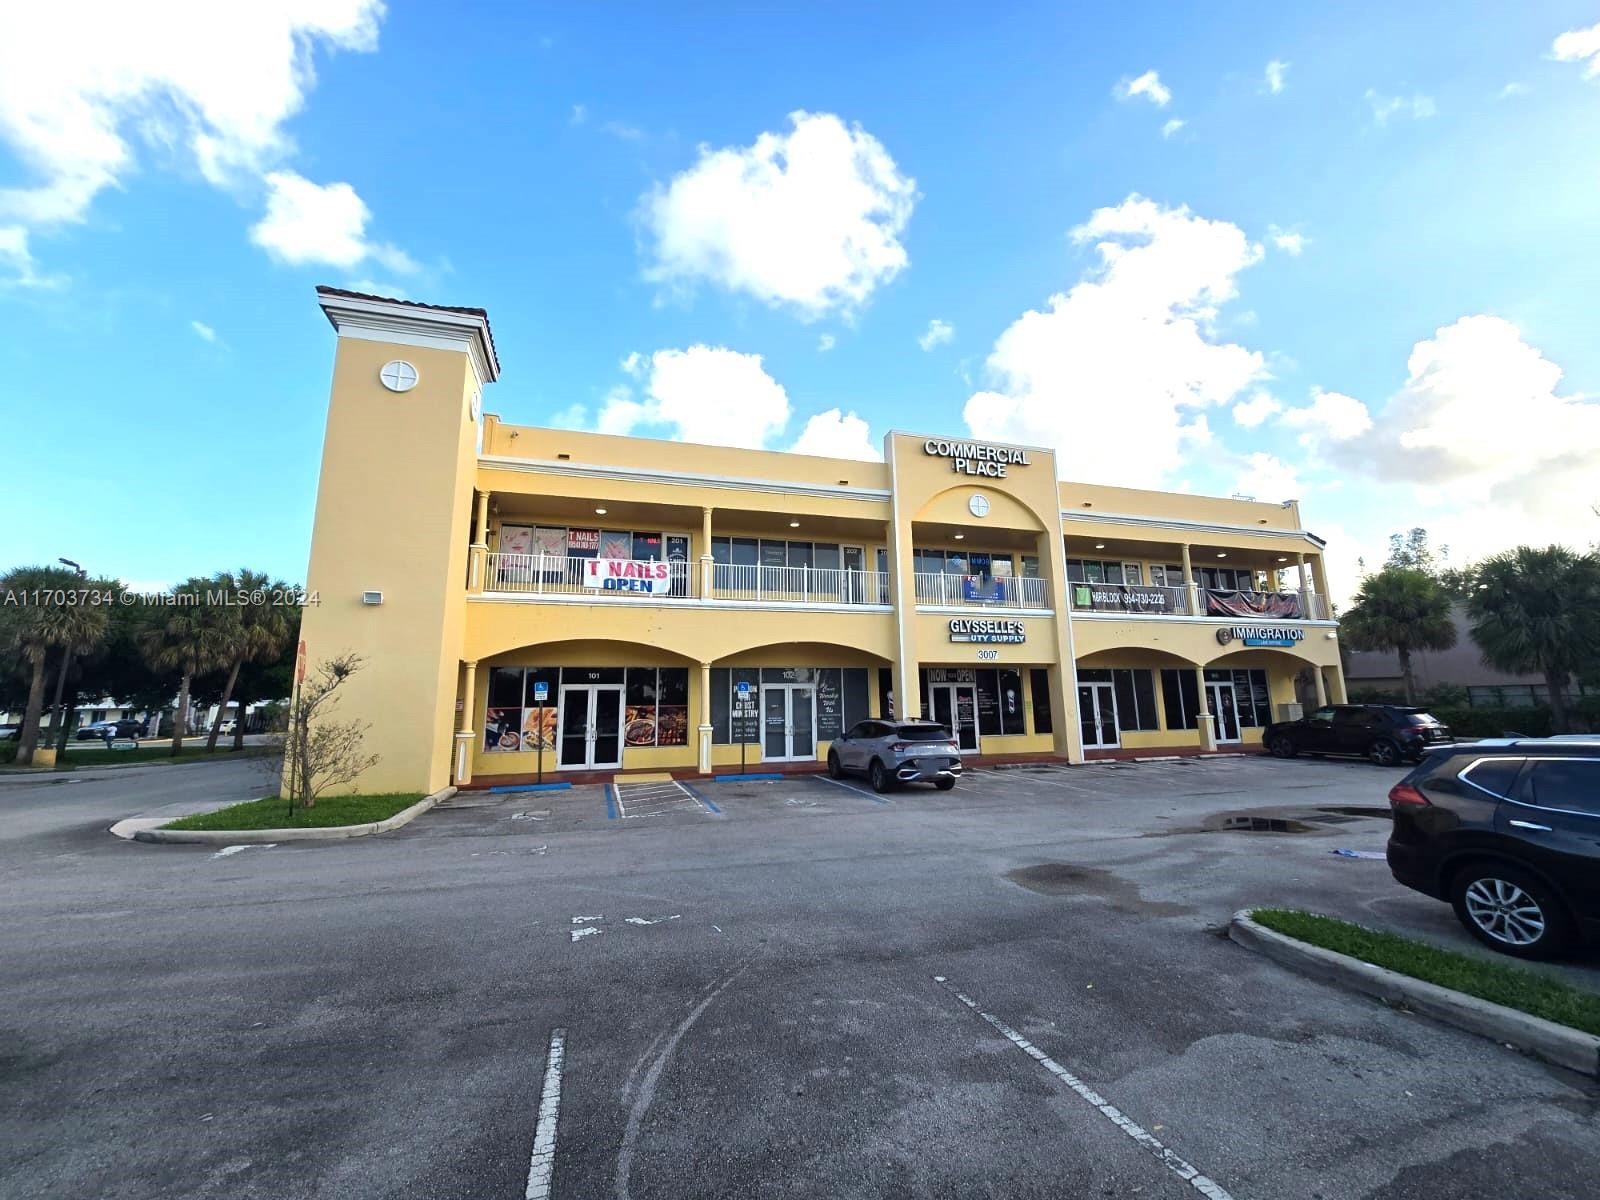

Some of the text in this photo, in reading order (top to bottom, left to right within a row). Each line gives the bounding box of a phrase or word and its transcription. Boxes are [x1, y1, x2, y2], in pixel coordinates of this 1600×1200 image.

[924, 439, 1031, 465] COMMERCIAL
[954, 458, 1007, 478] PLACE
[569, 531, 599, 541] T NAILS
[588, 561, 600, 576] T
[608, 561, 668, 579] NAILS
[603, 578, 653, 593] OPEN
[950, 620, 1025, 634] GLYSSELLE'S
[1233, 627, 1305, 640] IMMIGRATION
[991, 635, 1025, 643] SUPPLY
[978, 650, 998, 659] 3007
[783, 671, 795, 679] 102
[930, 669, 947, 682] NOW
[957, 669, 974, 682] OPEN
